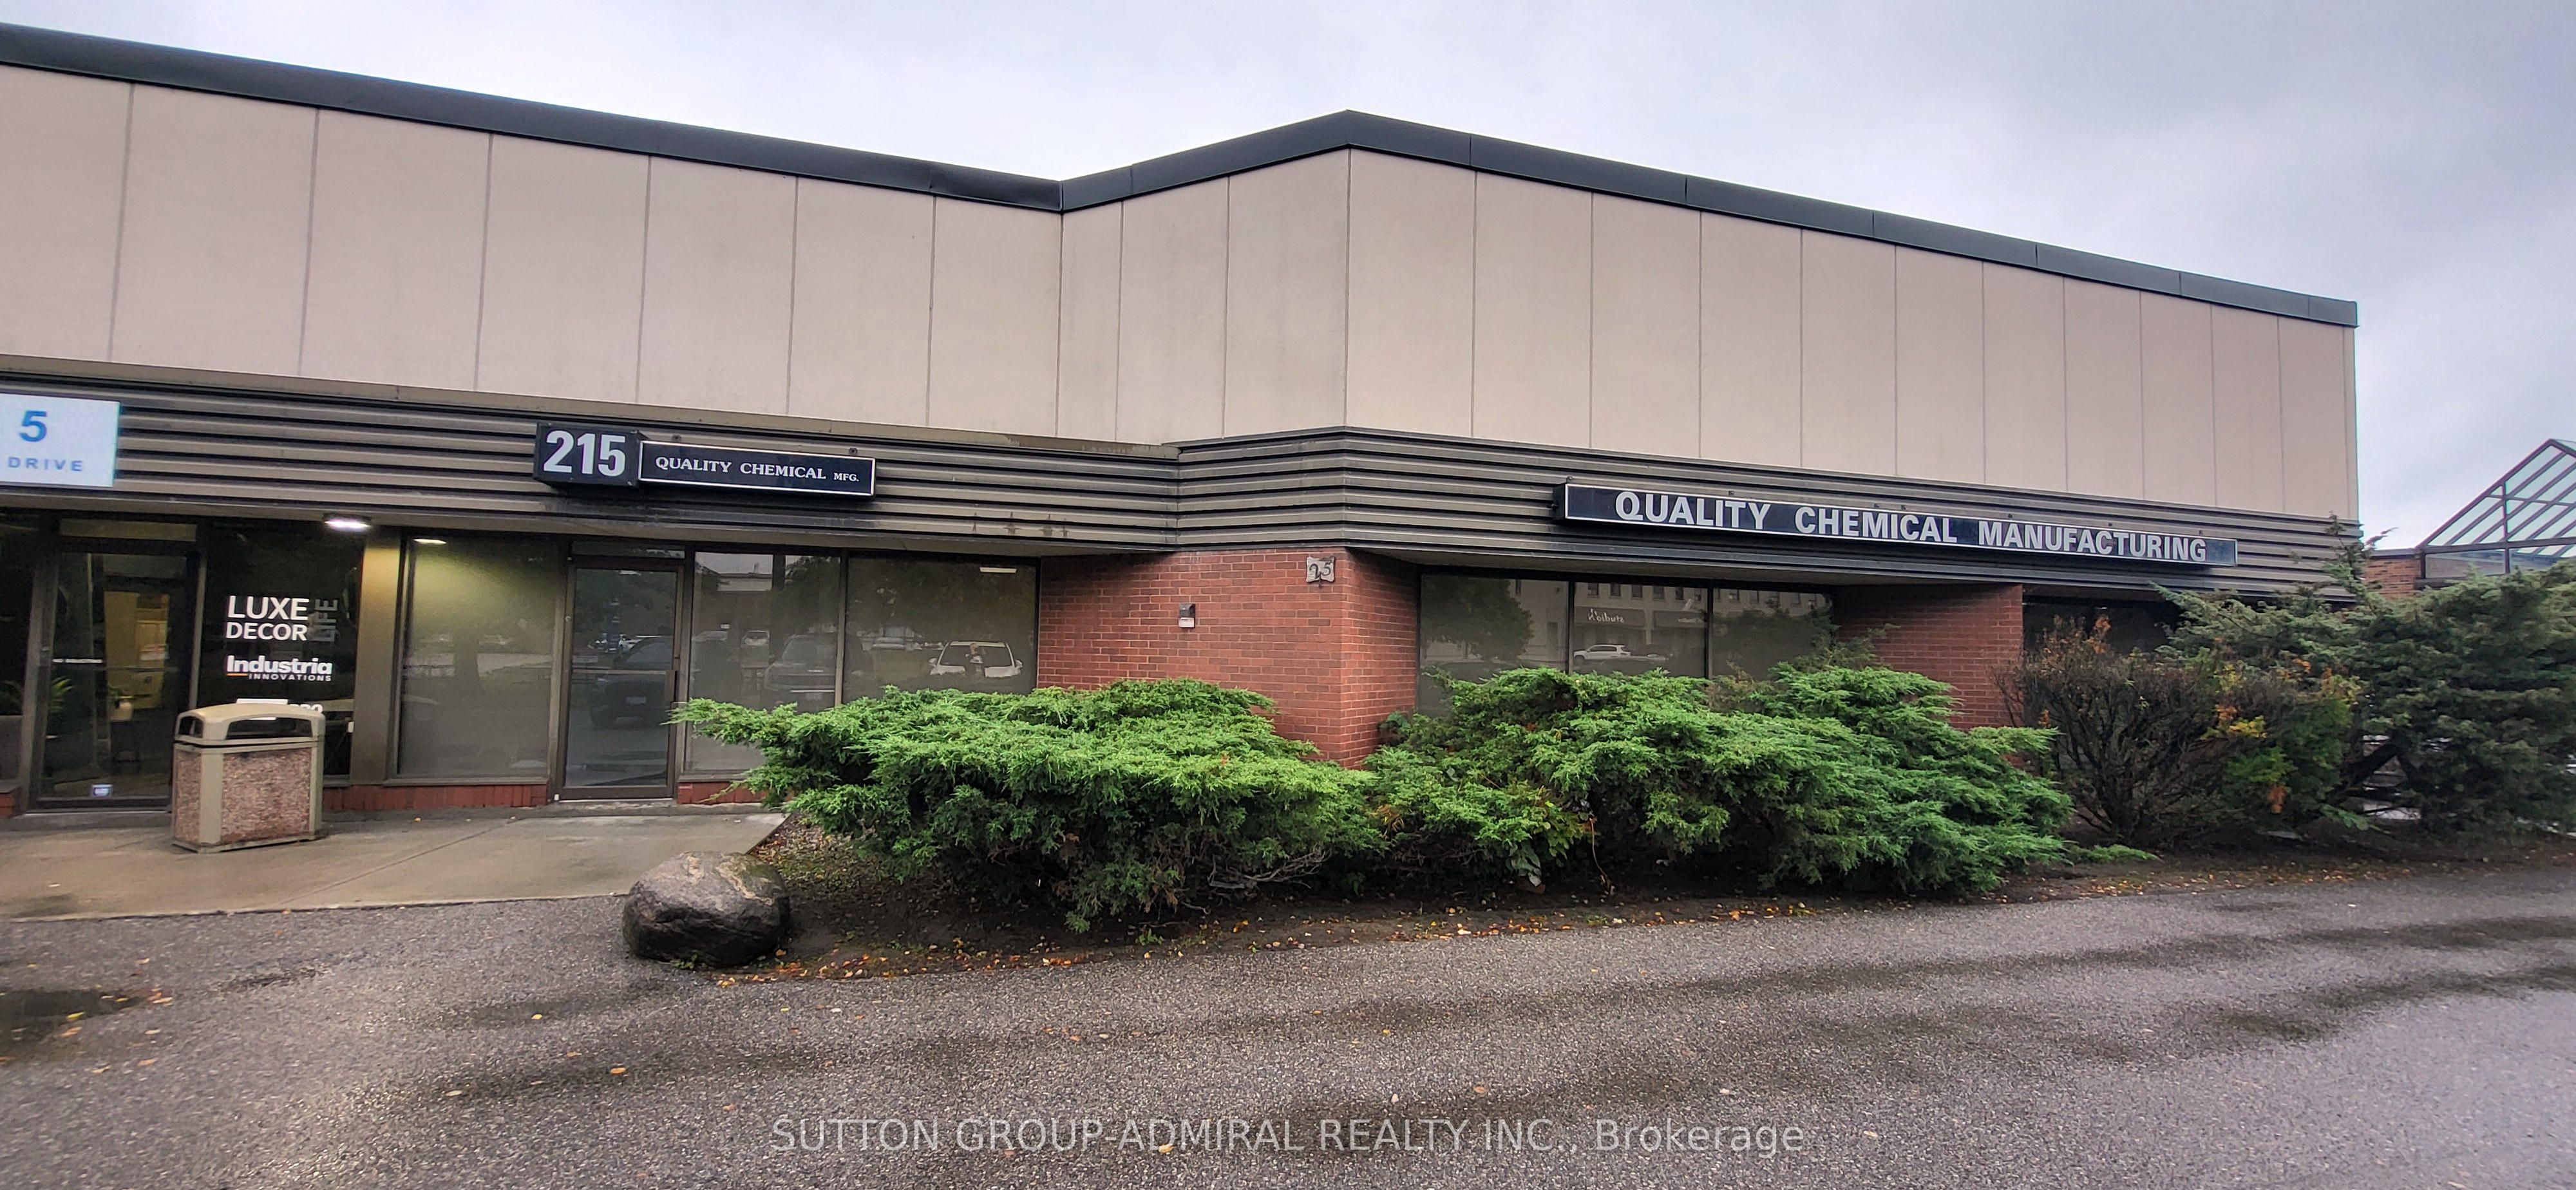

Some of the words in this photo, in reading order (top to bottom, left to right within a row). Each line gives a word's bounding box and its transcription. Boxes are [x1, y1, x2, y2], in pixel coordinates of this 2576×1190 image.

[19, 410, 47, 442] 5
[8, 457, 83, 471] DRIVE
[543, 430, 626, 477] 215
[656, 457, 732, 473] QUALITY
[741, 463, 826, 479] CHEMICAL
[833, 473, 859, 482] MFG.
[1615, 491, 1771, 529] QUALITY
[1795, 507, 1957, 543] CHEMICAL
[1978, 520, 2207, 562] MANUFACTURING
[228, 595, 310, 621] LUXE
[226, 621, 308, 641] DECOR
[227, 655, 333, 675] Industria
[249, 674, 332, 682] INNOVATIONS
